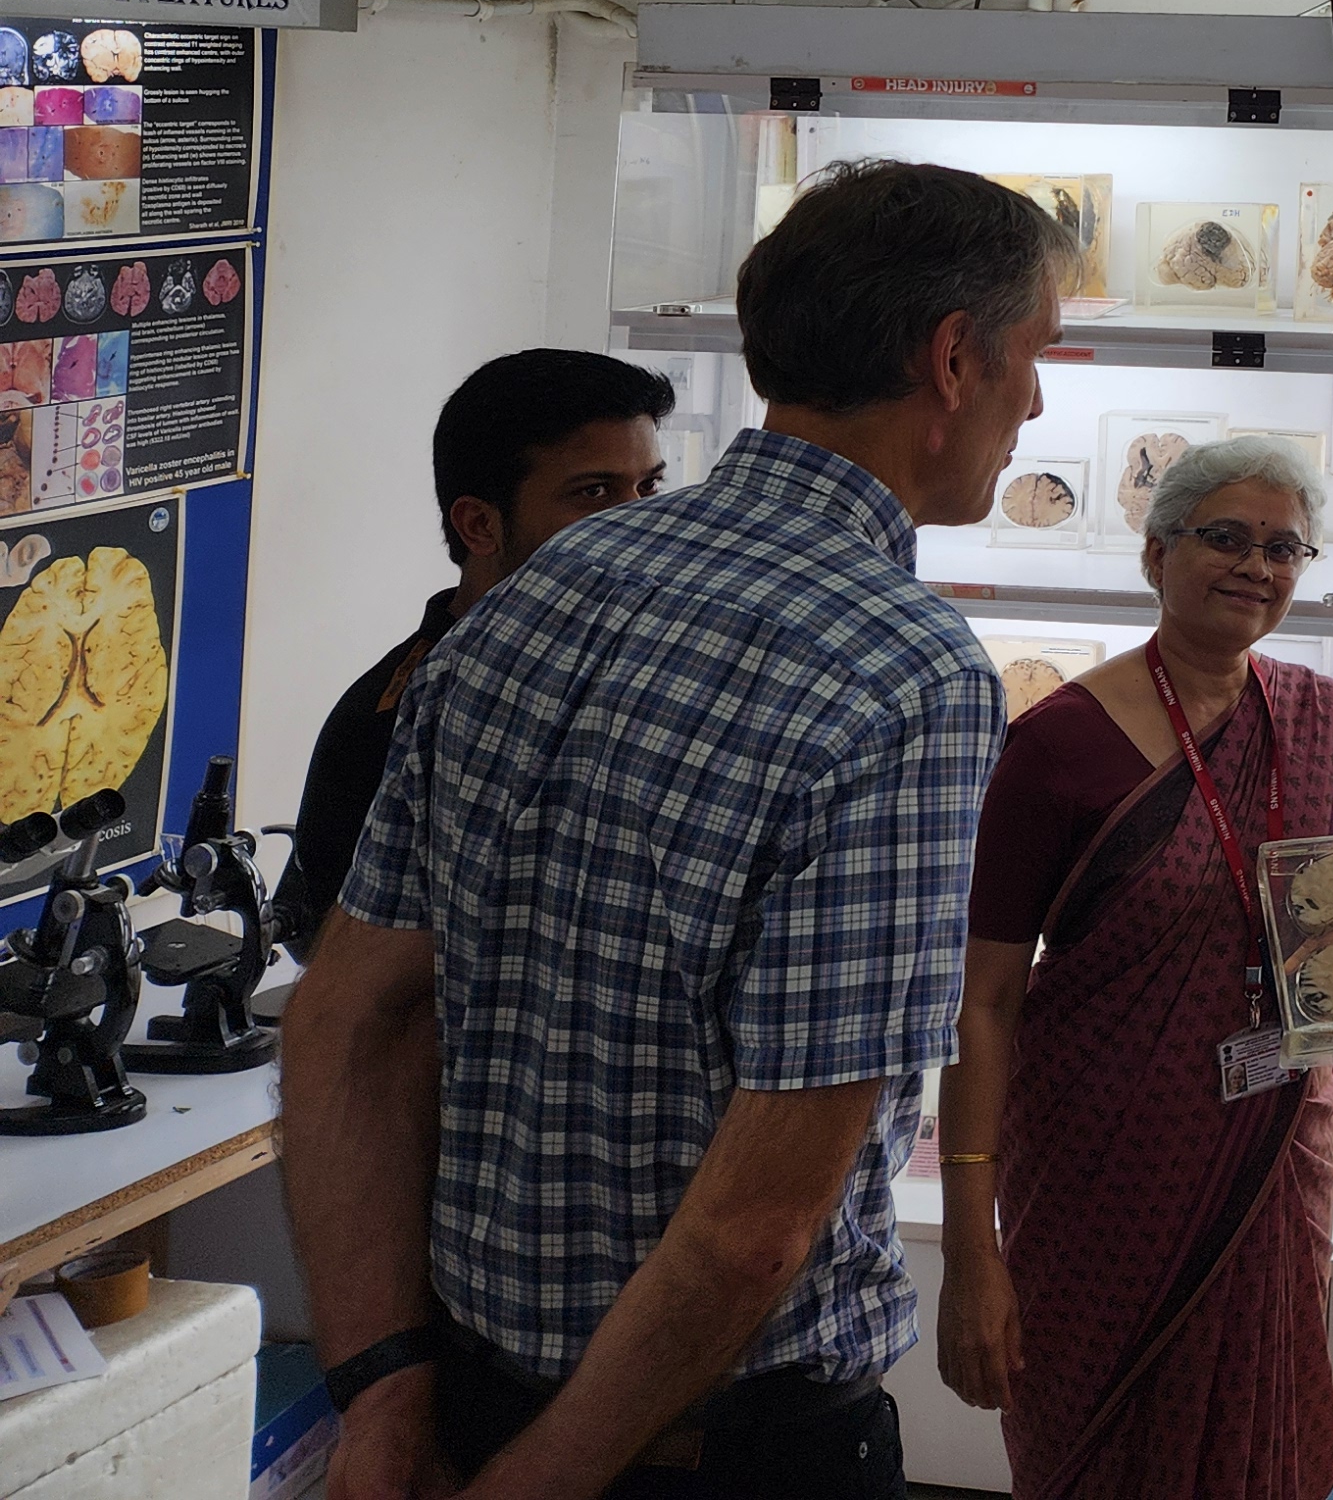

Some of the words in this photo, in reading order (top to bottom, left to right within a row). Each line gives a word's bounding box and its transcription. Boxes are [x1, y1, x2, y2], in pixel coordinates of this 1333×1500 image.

[884, 78, 927, 92] HEAD
[931, 79, 986, 94] INJURY
[125, 463, 158, 476] Varicella
[158, 458, 182, 470] zoster
[227, 448, 235, 457] in
[128, 477, 142, 488] HIV
[143, 473, 174, 486] positive
[174, 470, 184, 479] 45
[184, 467, 201, 479] year
[201, 463, 214, 473] old
[214, 460, 232, 471] male
[1181, 730, 1204, 772] NIMHANS
[1209, 798, 1231, 841] NIMHANS
